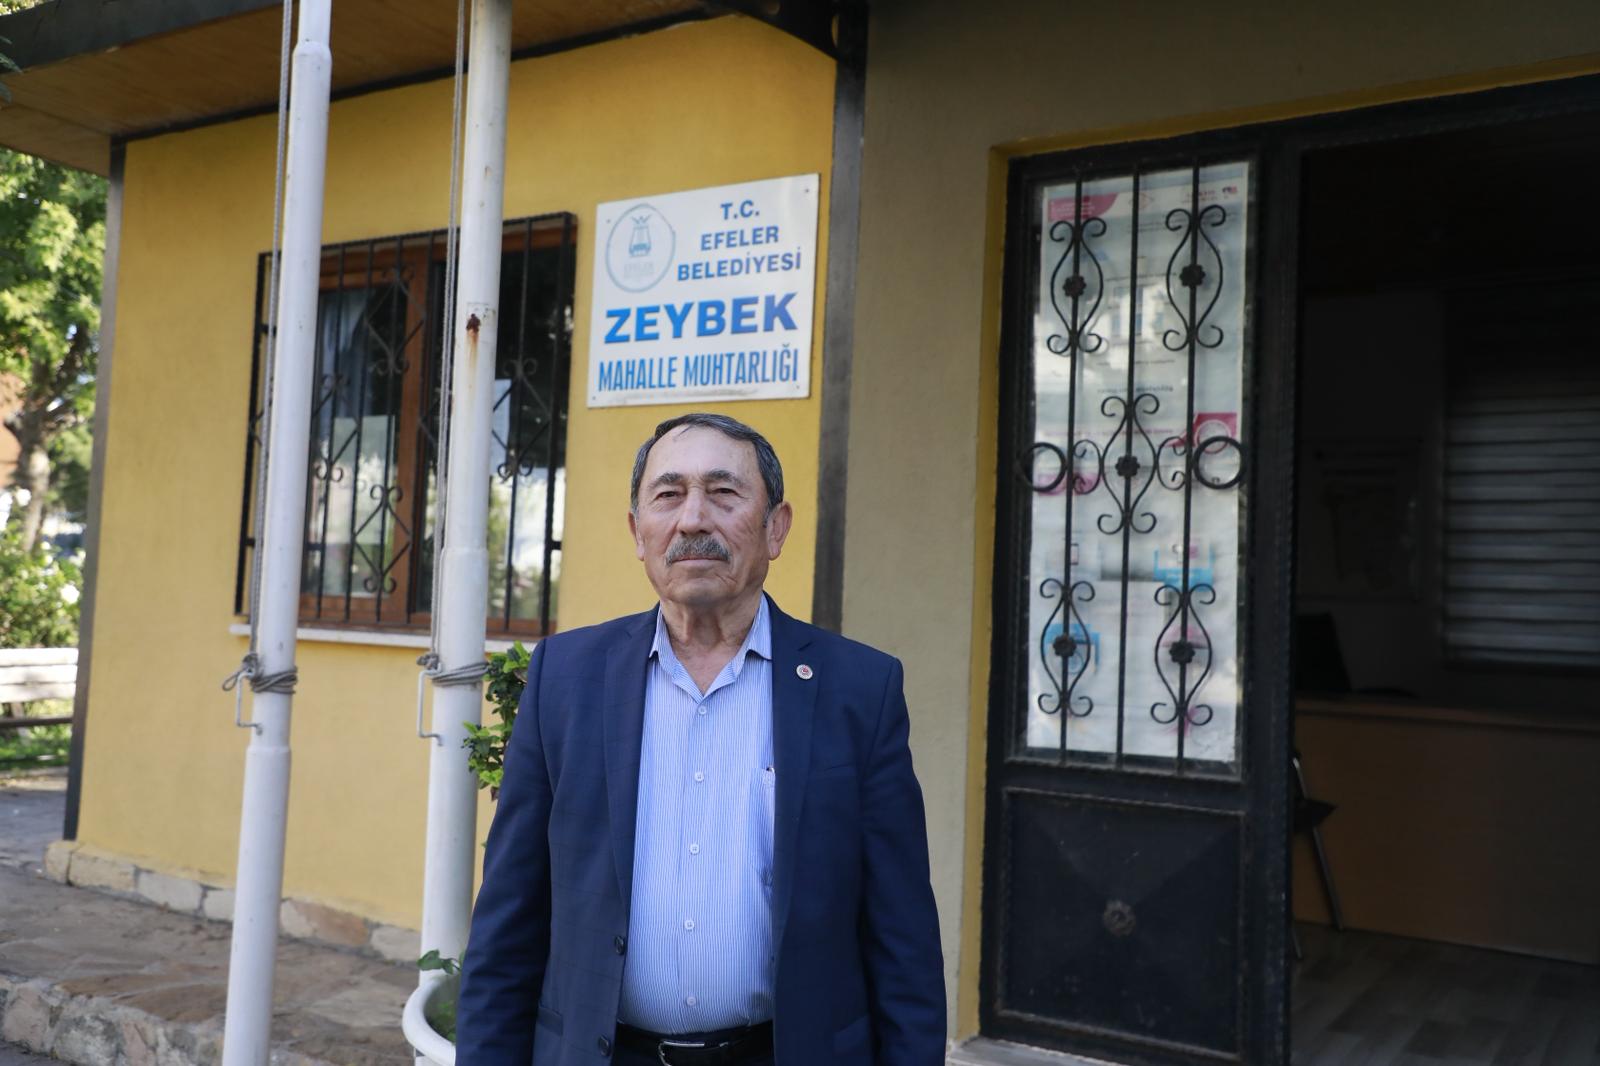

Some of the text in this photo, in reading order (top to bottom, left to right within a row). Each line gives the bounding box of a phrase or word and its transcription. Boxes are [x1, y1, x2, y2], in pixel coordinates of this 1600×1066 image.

[720, 200, 760, 220] T.C.
[701, 226, 779, 251] EFELER
[677, 246, 801, 281] BELEDİYESİ
[604, 292, 798, 344] ZEYBEK
[598, 343, 798, 392] MAHALLE MUHTARLIĞI
